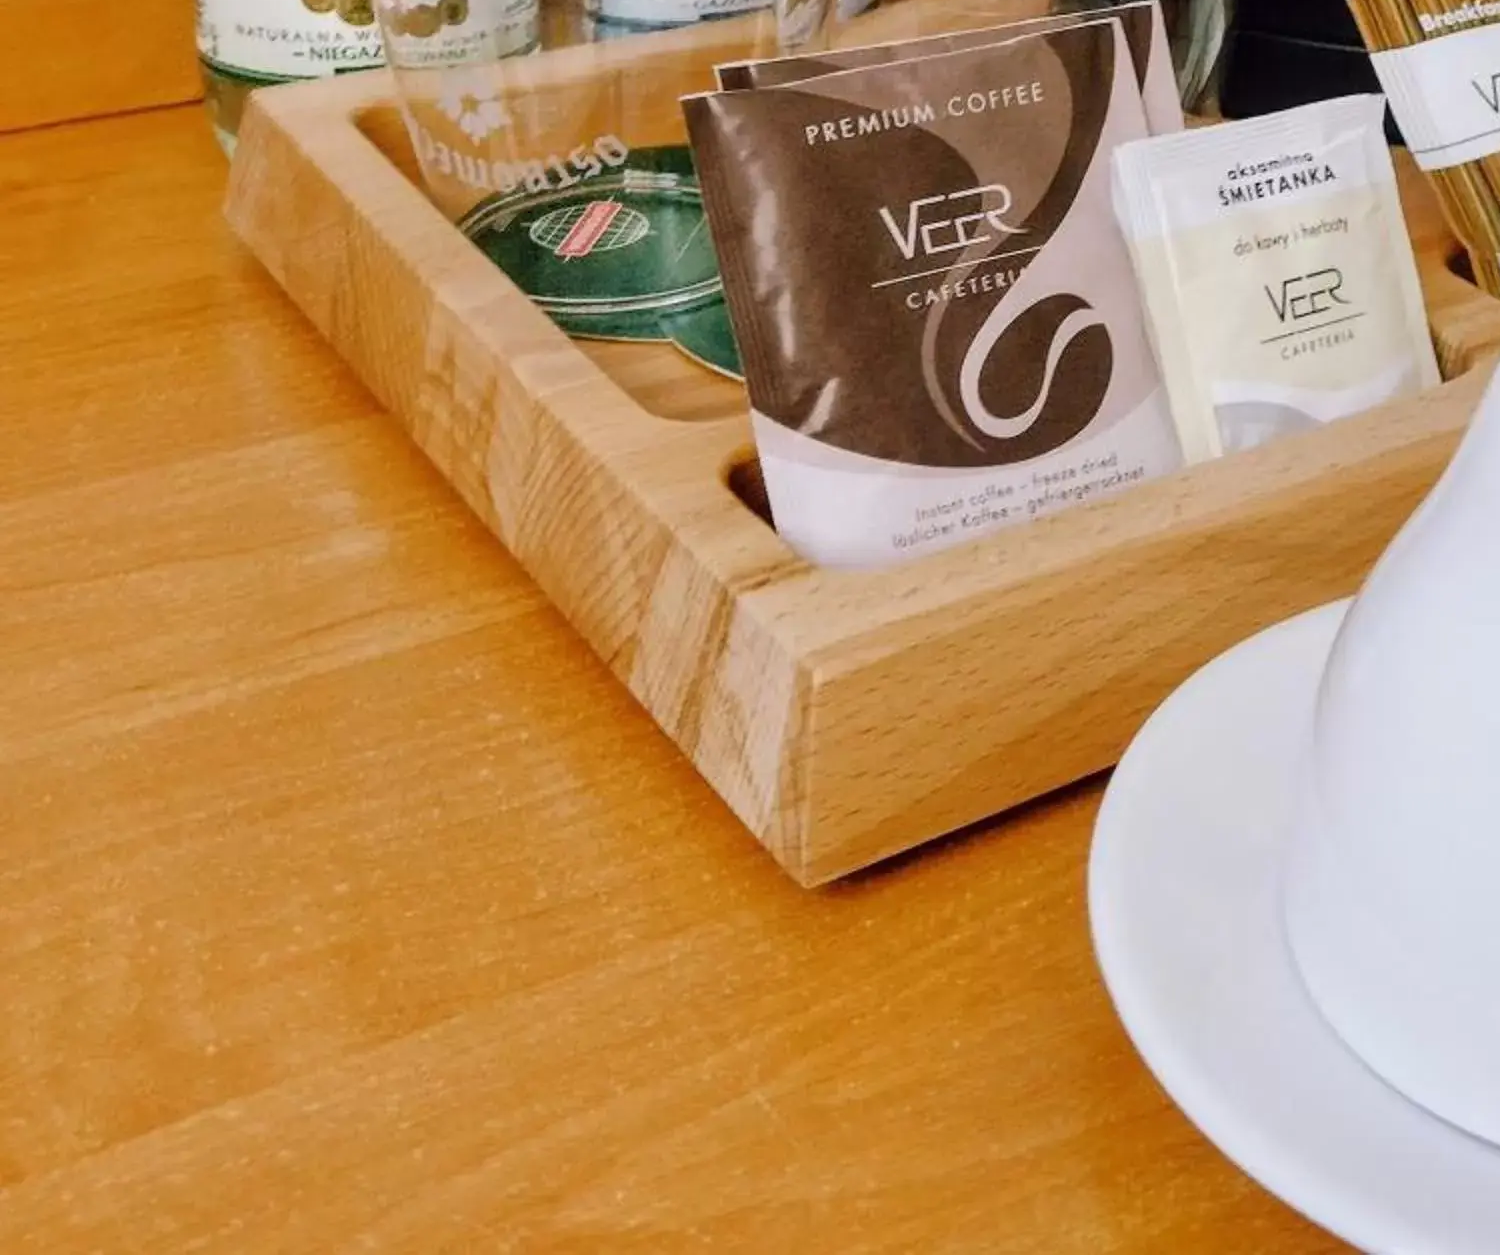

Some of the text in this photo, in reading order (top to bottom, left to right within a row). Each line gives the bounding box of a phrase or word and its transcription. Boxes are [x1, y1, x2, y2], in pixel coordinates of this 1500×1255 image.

[804, 81, 1045, 146] PREMIUM COFFEE
[1218, 163, 1337, 207] ŚMIETANKA
[878, 183, 1031, 260] VEER
[1232, 233, 1254, 257] do
[1254, 232, 1290, 251] kawy
[1299, 216, 1349, 241] herbaty
[1263, 266, 1353, 325] VEER
[1279, 329, 1357, 361] CAFETERIA
[968, 485, 1014, 507] coffee
[1031, 466, 1077, 488] freeze
[1081, 452, 1119, 475] dried
